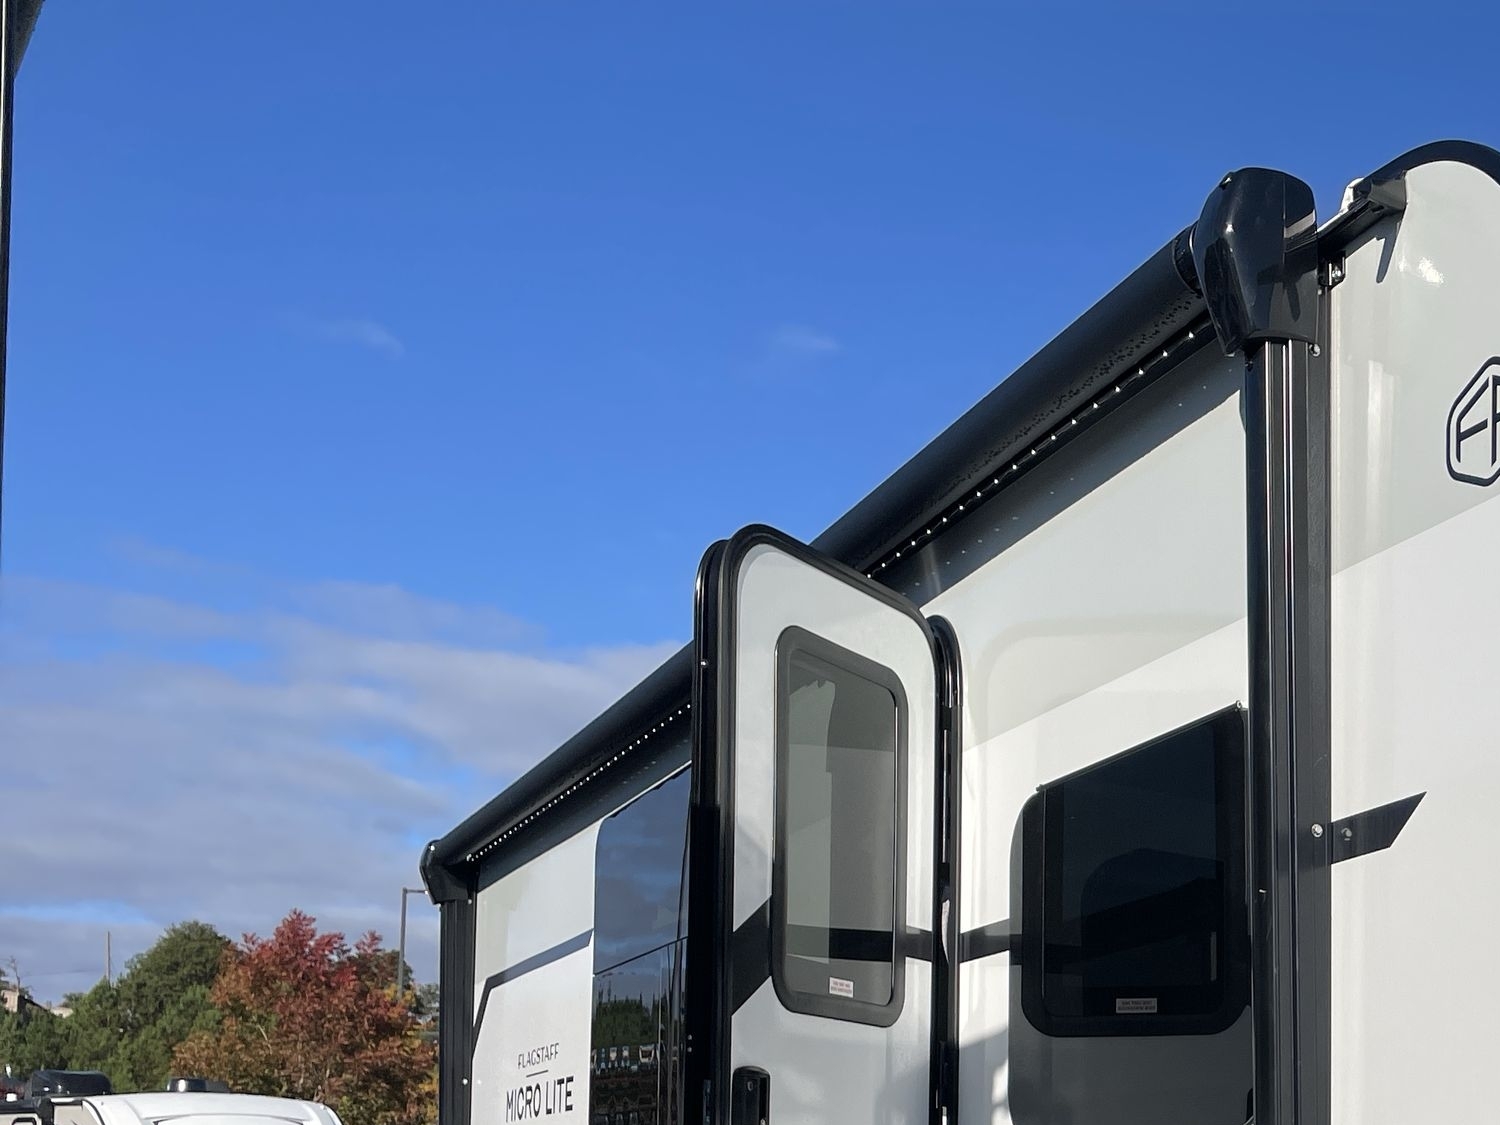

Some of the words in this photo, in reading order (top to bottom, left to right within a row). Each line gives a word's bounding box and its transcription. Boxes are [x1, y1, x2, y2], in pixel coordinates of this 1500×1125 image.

[517, 1042, 560, 1070] FLAGSTAFF
[505, 1083, 542, 1123] MICRO
[545, 1075, 575, 1115] LITE
